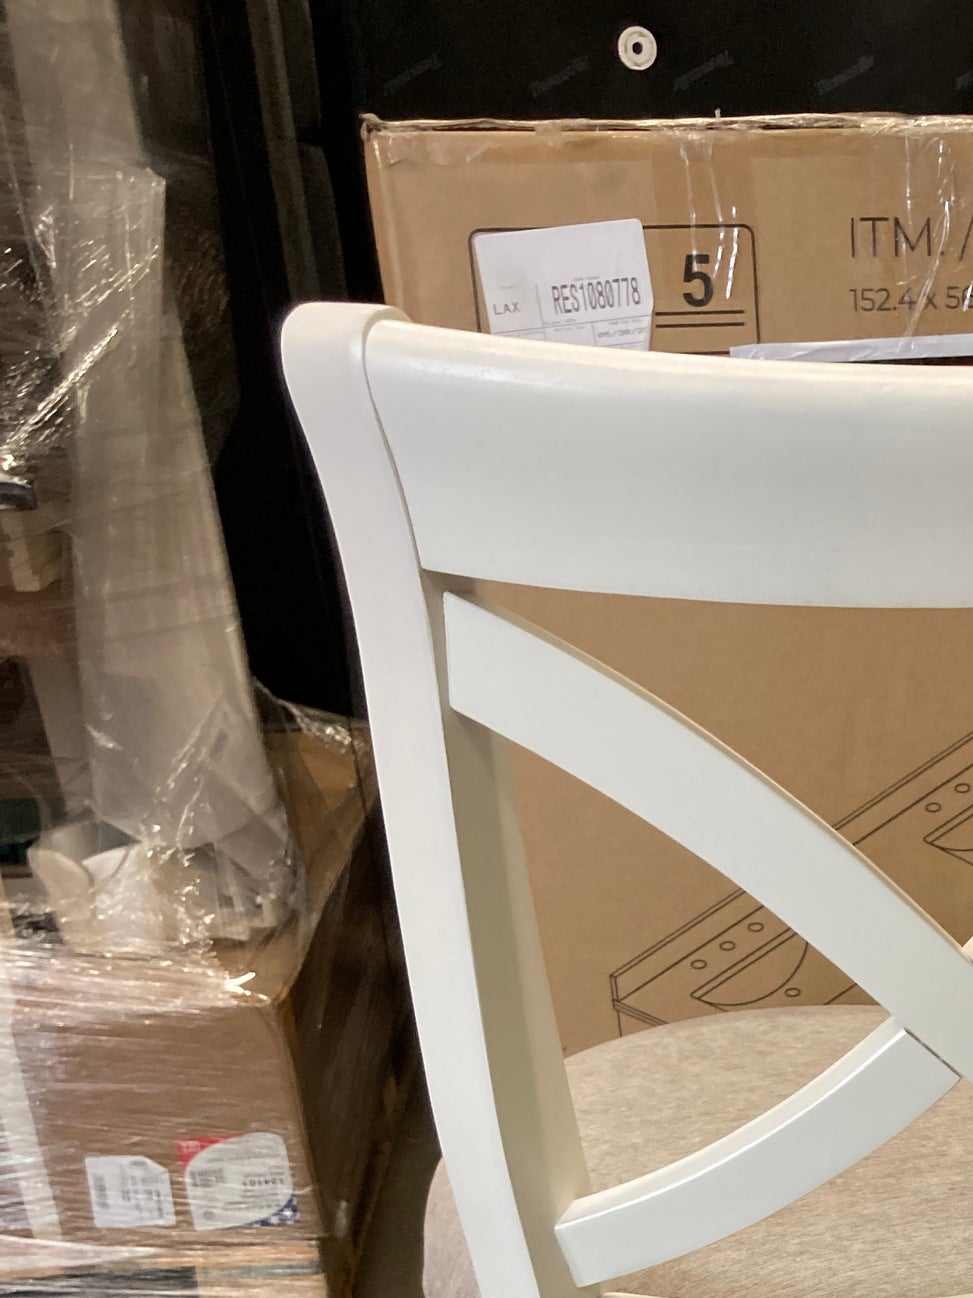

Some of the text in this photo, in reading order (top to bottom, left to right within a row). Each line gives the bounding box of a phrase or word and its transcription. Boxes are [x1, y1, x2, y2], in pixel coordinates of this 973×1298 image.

[850, 216, 946, 258] ITM.
[550, 276, 641, 316] RES1080778
[682, 253, 714, 308] 5
[493, 301, 521, 316] LAX
